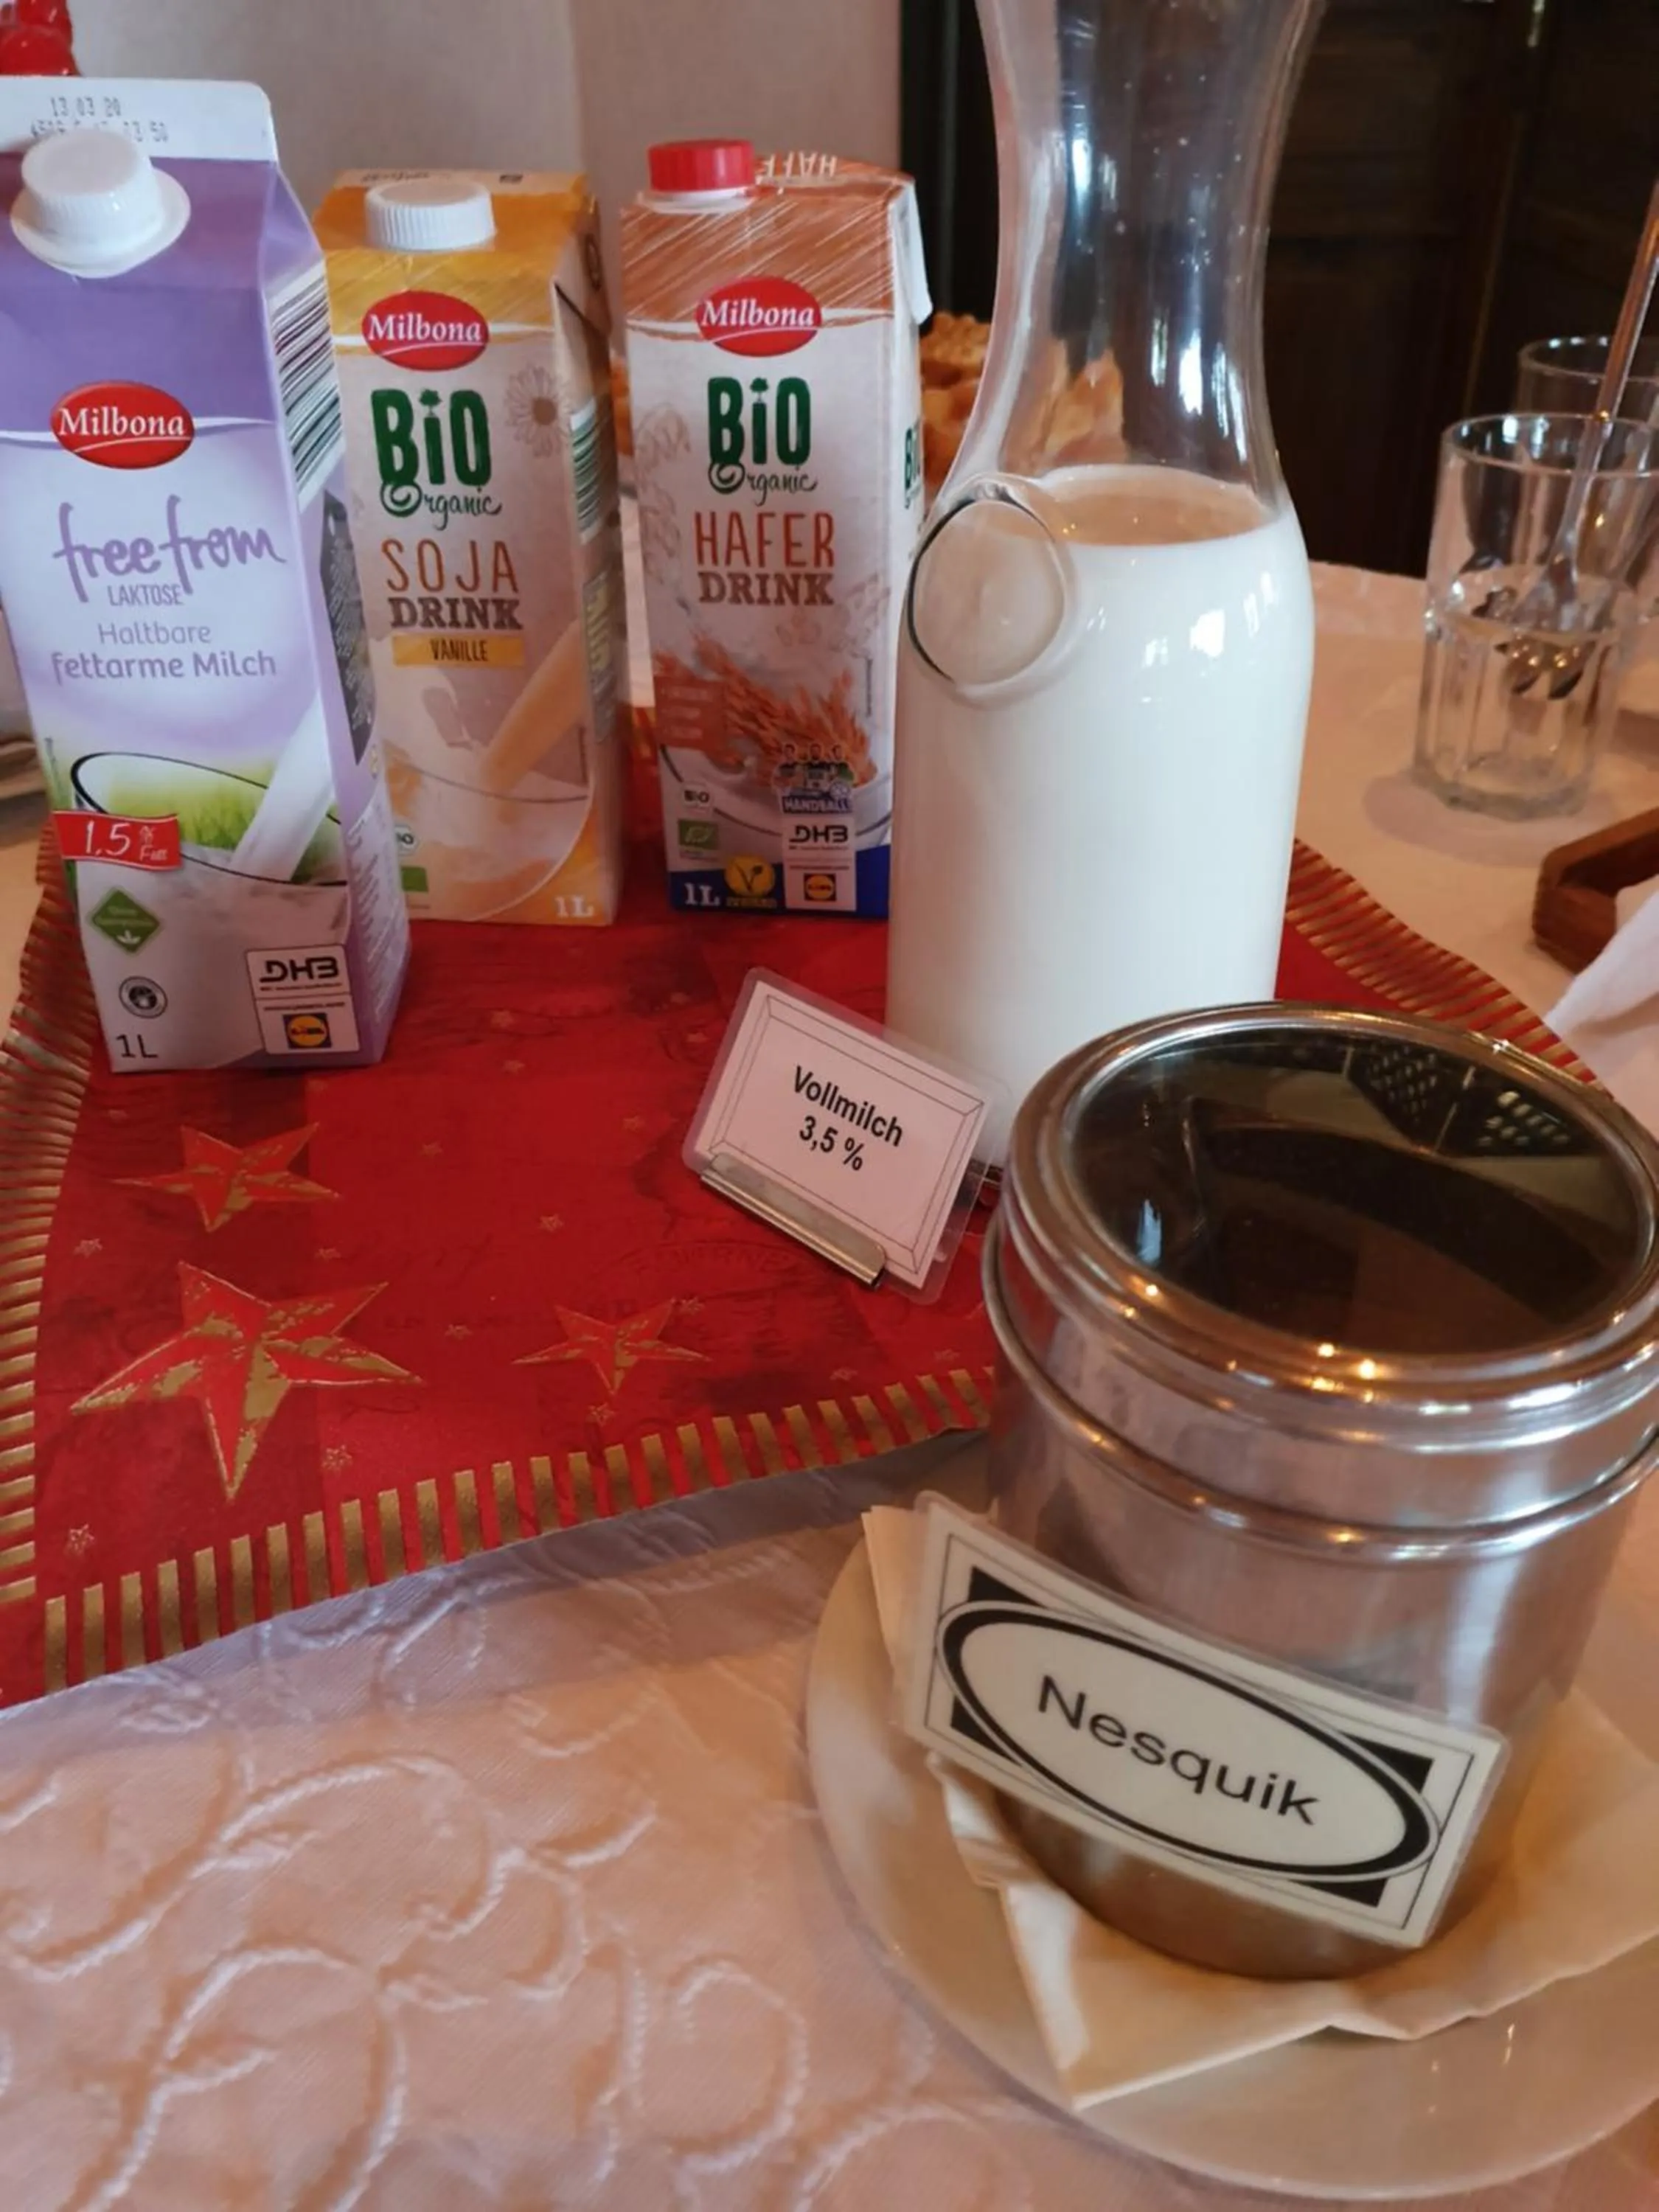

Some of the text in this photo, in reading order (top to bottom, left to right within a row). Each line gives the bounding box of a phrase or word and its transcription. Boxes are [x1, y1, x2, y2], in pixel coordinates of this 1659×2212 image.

[368, 312, 482, 341] Milbona
[701, 299, 815, 327] Milbona
[58, 406, 185, 437] Milbona
[708, 462, 818, 507] Organic
[380, 480, 503, 531] Organic
[52, 494, 288, 604] free from
[695, 510, 835, 568] HAFER
[381, 538, 519, 594] SOJA
[108, 584, 184, 606] LAKTOSE
[698, 571, 835, 606] DRINK
[388, 597, 524, 630] DRINK
[97, 622, 212, 645] Haltbare
[430, 639, 490, 663] VANILLE
[52, 650, 277, 686] fettarme Milch
[789, 825, 849, 843] DHB
[554, 895, 594, 918] 1L
[684, 883, 720, 907] 1L
[259, 956, 339, 983] DHB
[116, 1033, 160, 1058] 1L
[793, 1065, 903, 1147] Vollmilch
[799, 1115, 863, 1172] 3,5 %
[1038, 1674, 1320, 1826] Nesquik
